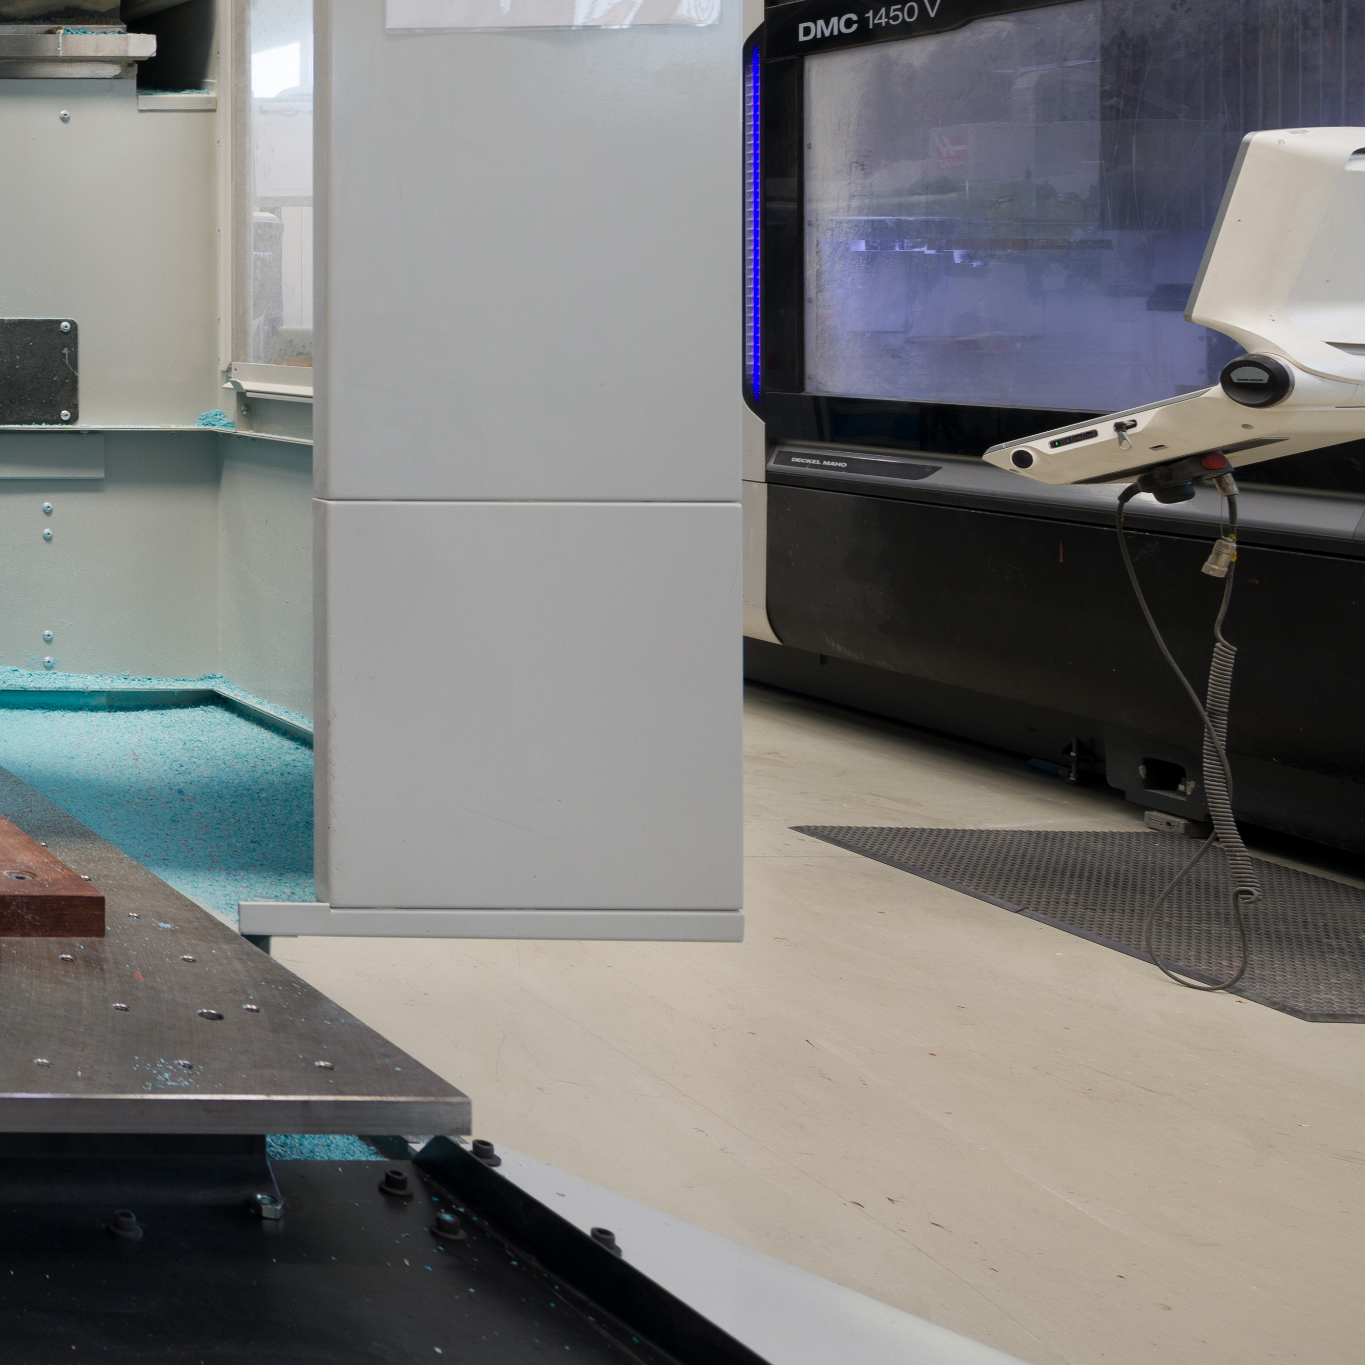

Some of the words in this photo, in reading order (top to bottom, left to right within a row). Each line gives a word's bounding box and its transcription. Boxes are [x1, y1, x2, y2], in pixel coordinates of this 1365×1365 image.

[798, 13, 859, 42] DMC
[865, 1, 918, 29] 1450
[791, 457, 821, 465] DECKEL
[822, 460, 848, 468] MAHO
